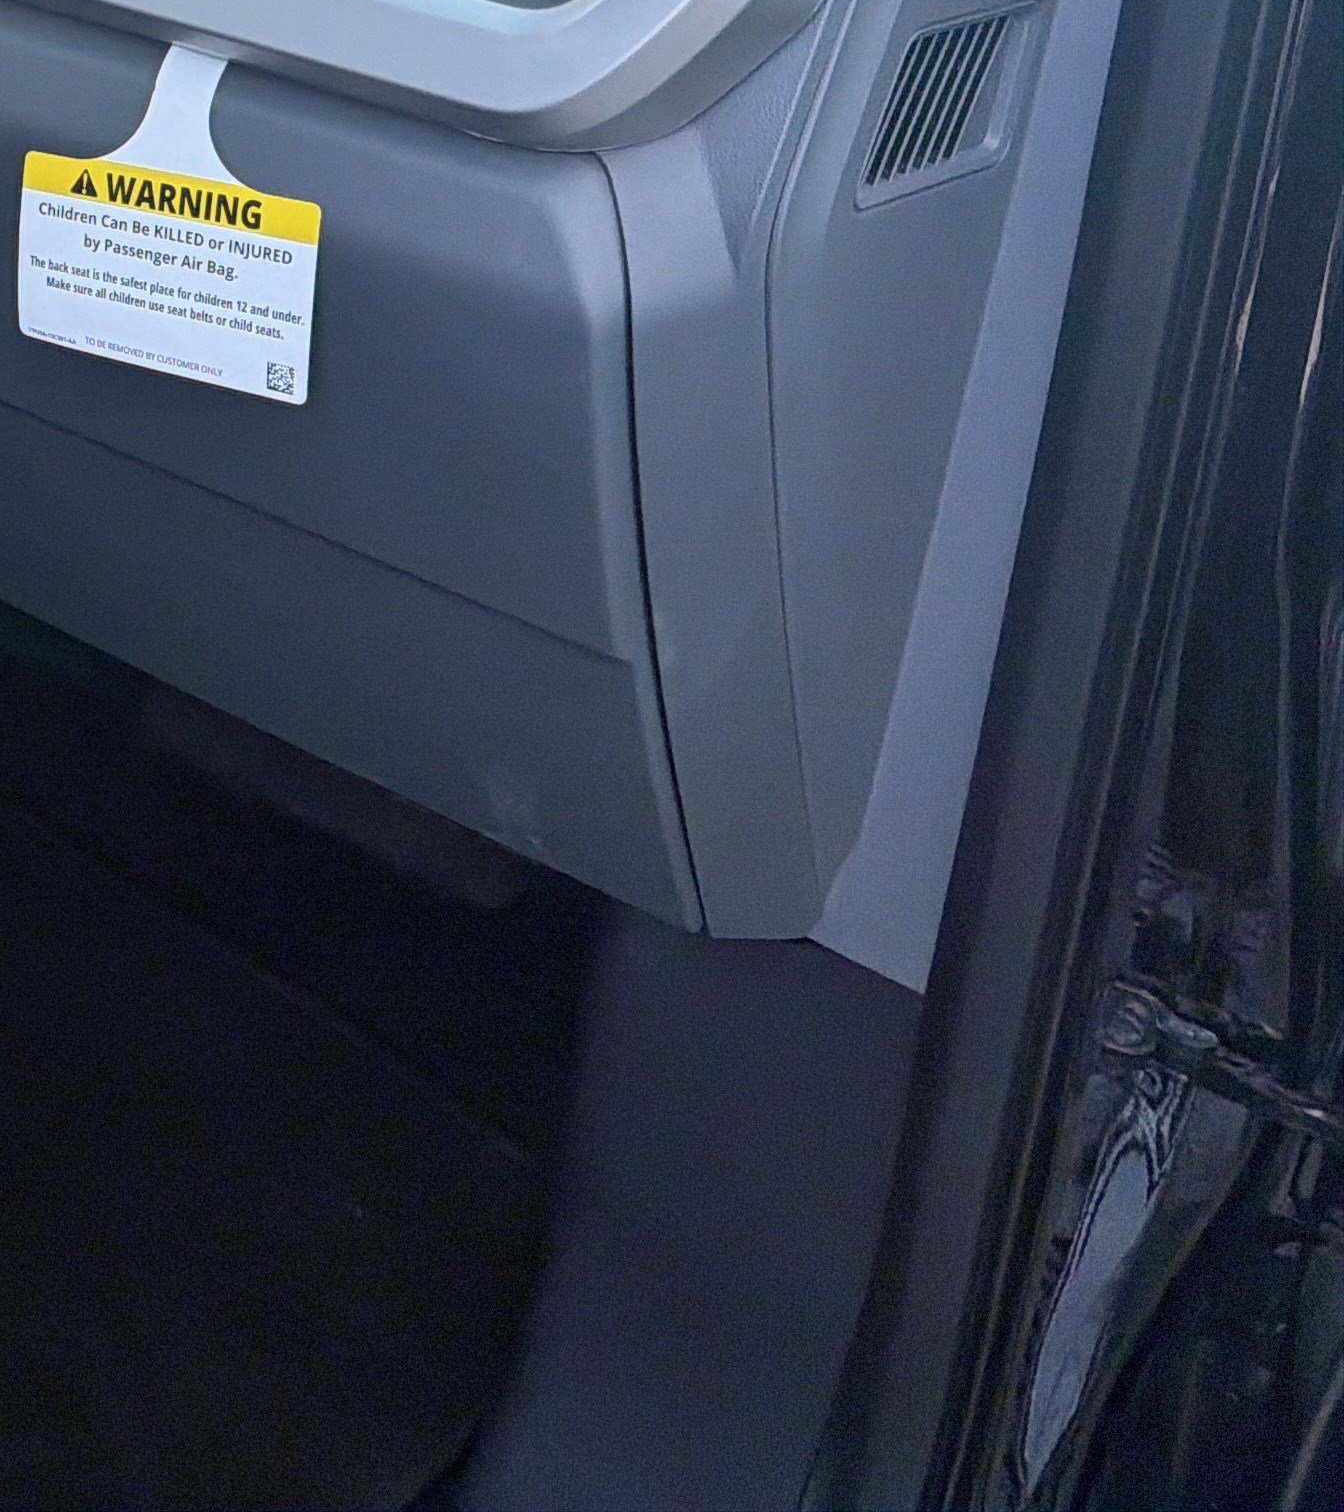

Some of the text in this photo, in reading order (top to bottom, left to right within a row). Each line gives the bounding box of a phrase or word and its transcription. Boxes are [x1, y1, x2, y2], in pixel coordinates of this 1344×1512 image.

[106, 172, 263, 230] WARNING
[38, 201, 293, 265] Children Can Be KILLED or INJURED
[83, 233, 239, 282] by Passenger Air Bag.
[30, 255, 305, 326] The back seat is the safest place for children 12 and under.
[46, 276, 285, 340] Make sure all children use seat belts or child seats.
[84, 335, 96, 347] TO
[96, 339, 107, 350] BE
[107, 342, 144, 359] REMOVED
[145, 351, 156, 361] BY
[156, 354, 200, 372] CUSTOMER
[200, 365, 223, 378] ONLY
